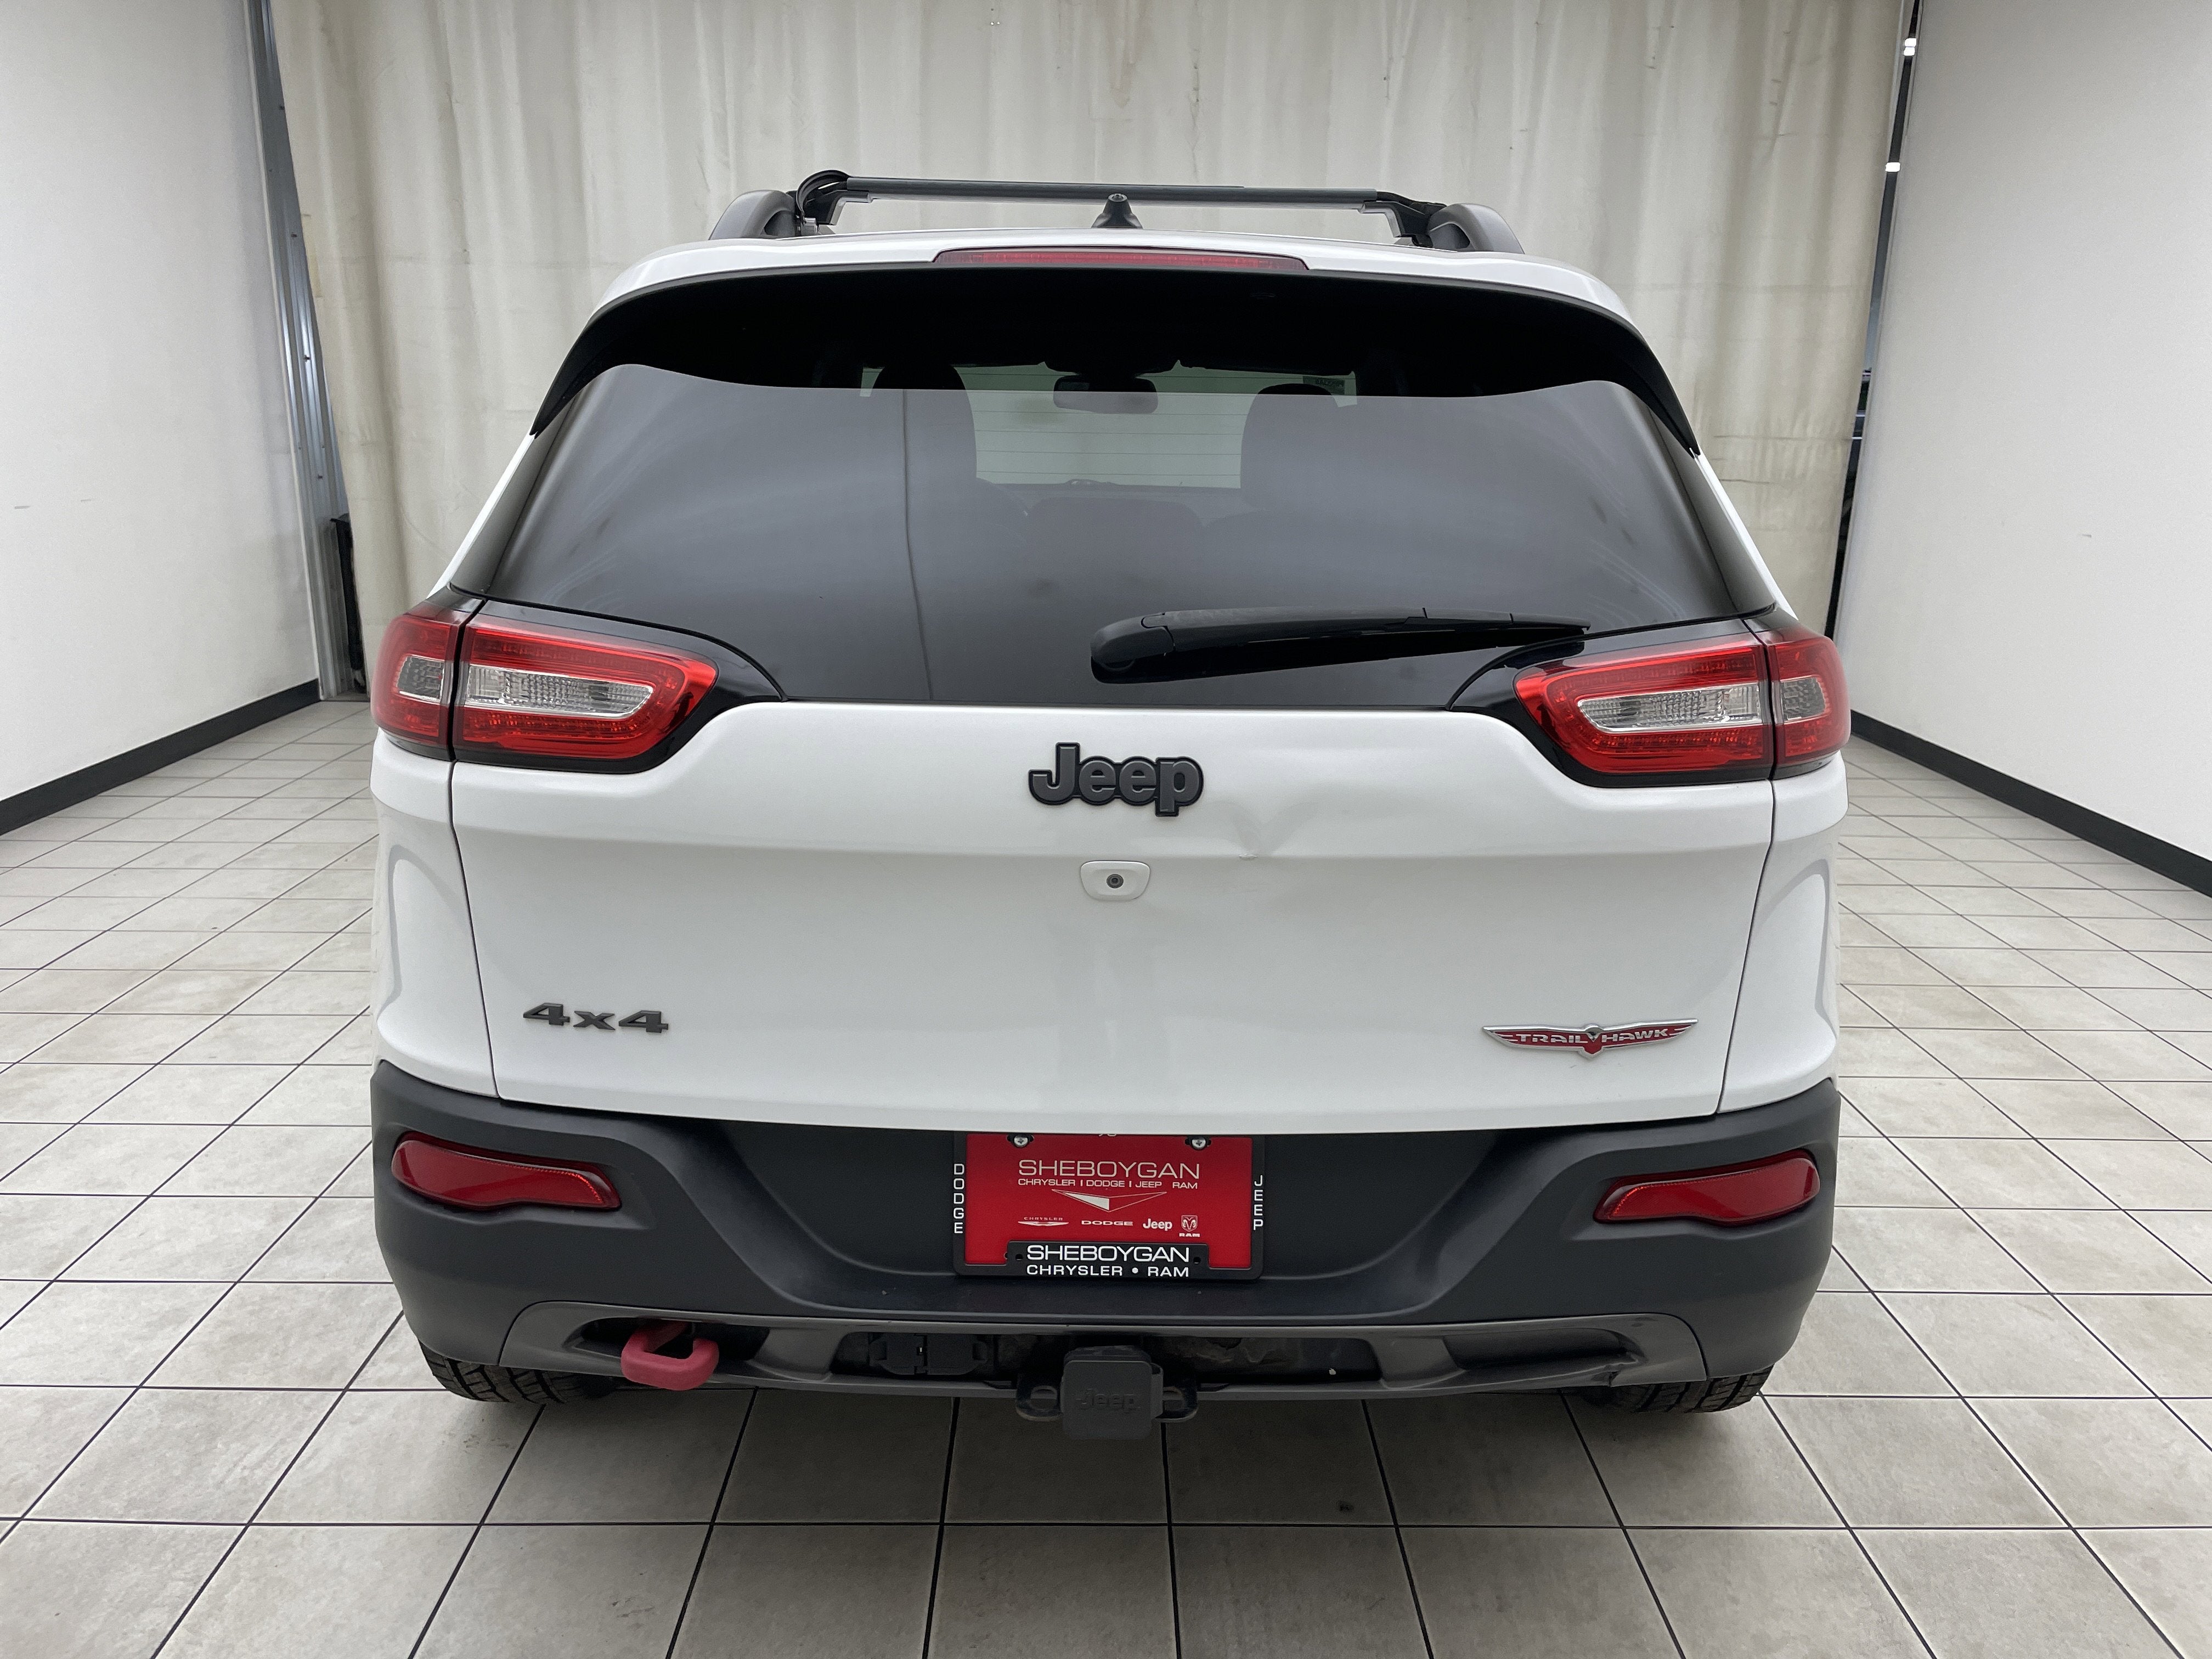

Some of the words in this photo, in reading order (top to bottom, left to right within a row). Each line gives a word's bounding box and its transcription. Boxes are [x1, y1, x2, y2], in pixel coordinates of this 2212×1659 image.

[1029, 742, 1204, 817] Jeep
[1018, 1159, 1200, 1180] SHEBOYGAN
[1018, 1178, 1076, 1187] CHRYSLER
[1086, 1180, 1125, 1188] DODGE
[953, 1164, 964, 1233] DODGE
[1253, 1175, 1263, 1231] JEEP
[1143, 1218, 1172, 1231] Jeep
[1027, 1245, 1189, 1262] SHEBOYGAN
[1026, 1264, 1122, 1276] CHRYSLER
[1148, 1266, 1189, 1277] RAM
[1075, 1388, 1137, 1414] Jeep
